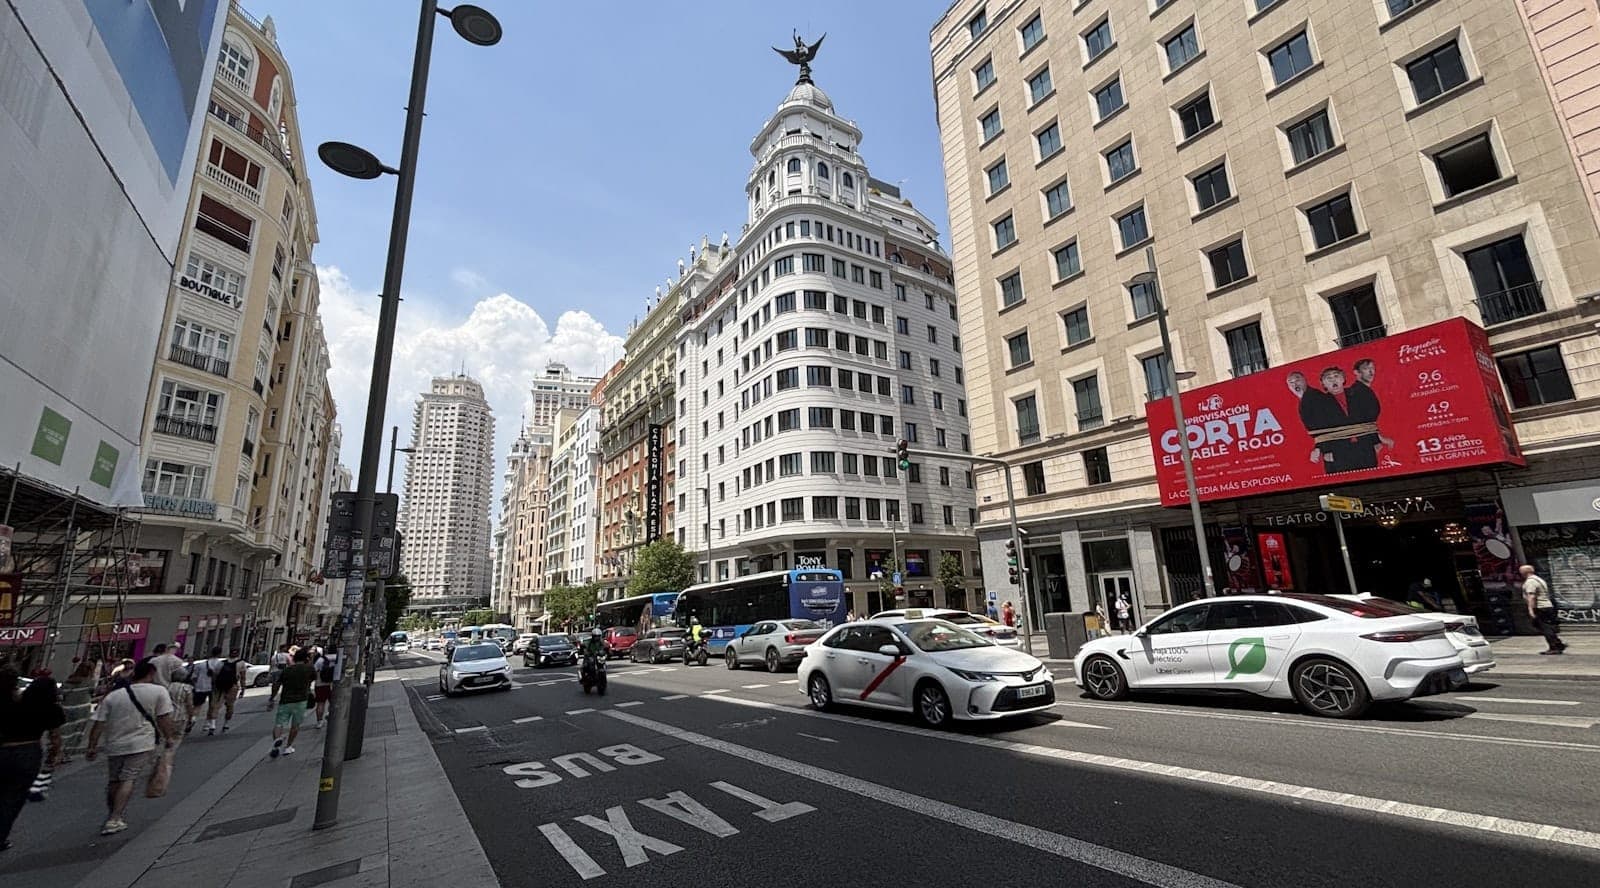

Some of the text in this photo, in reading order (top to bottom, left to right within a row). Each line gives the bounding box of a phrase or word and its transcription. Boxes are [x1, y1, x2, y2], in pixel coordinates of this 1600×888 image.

[180, 276, 231, 304] BOUTIQUE
[1418, 370, 1442, 384] 9.6
[1184, 404, 1250, 426] PROVISACIÓN
[1427, 401, 1450, 414] 4.9
[1160, 408, 1282, 453] CORTA
[1163, 455, 1180, 466] EL
[1238, 433, 1284, 452] ROJO
[1416, 438, 1441, 453] 13
[1444, 441, 1456, 450] DE
[1421, 454, 1432, 463] EN
[1433, 453, 1445, 461] LA
[1445, 450, 1470, 460] GRAN
[1168, 491, 1179, 499] LA
[1220, 481, 1240, 492] MÁS
[1241, 474, 1293, 489] EXPLOSIVA
[1266, 512, 1327, 526] TEATRO
[798, 555, 822, 565] TONY
[503, 743, 665, 788] BUS
[537, 780, 818, 880] TAXI
